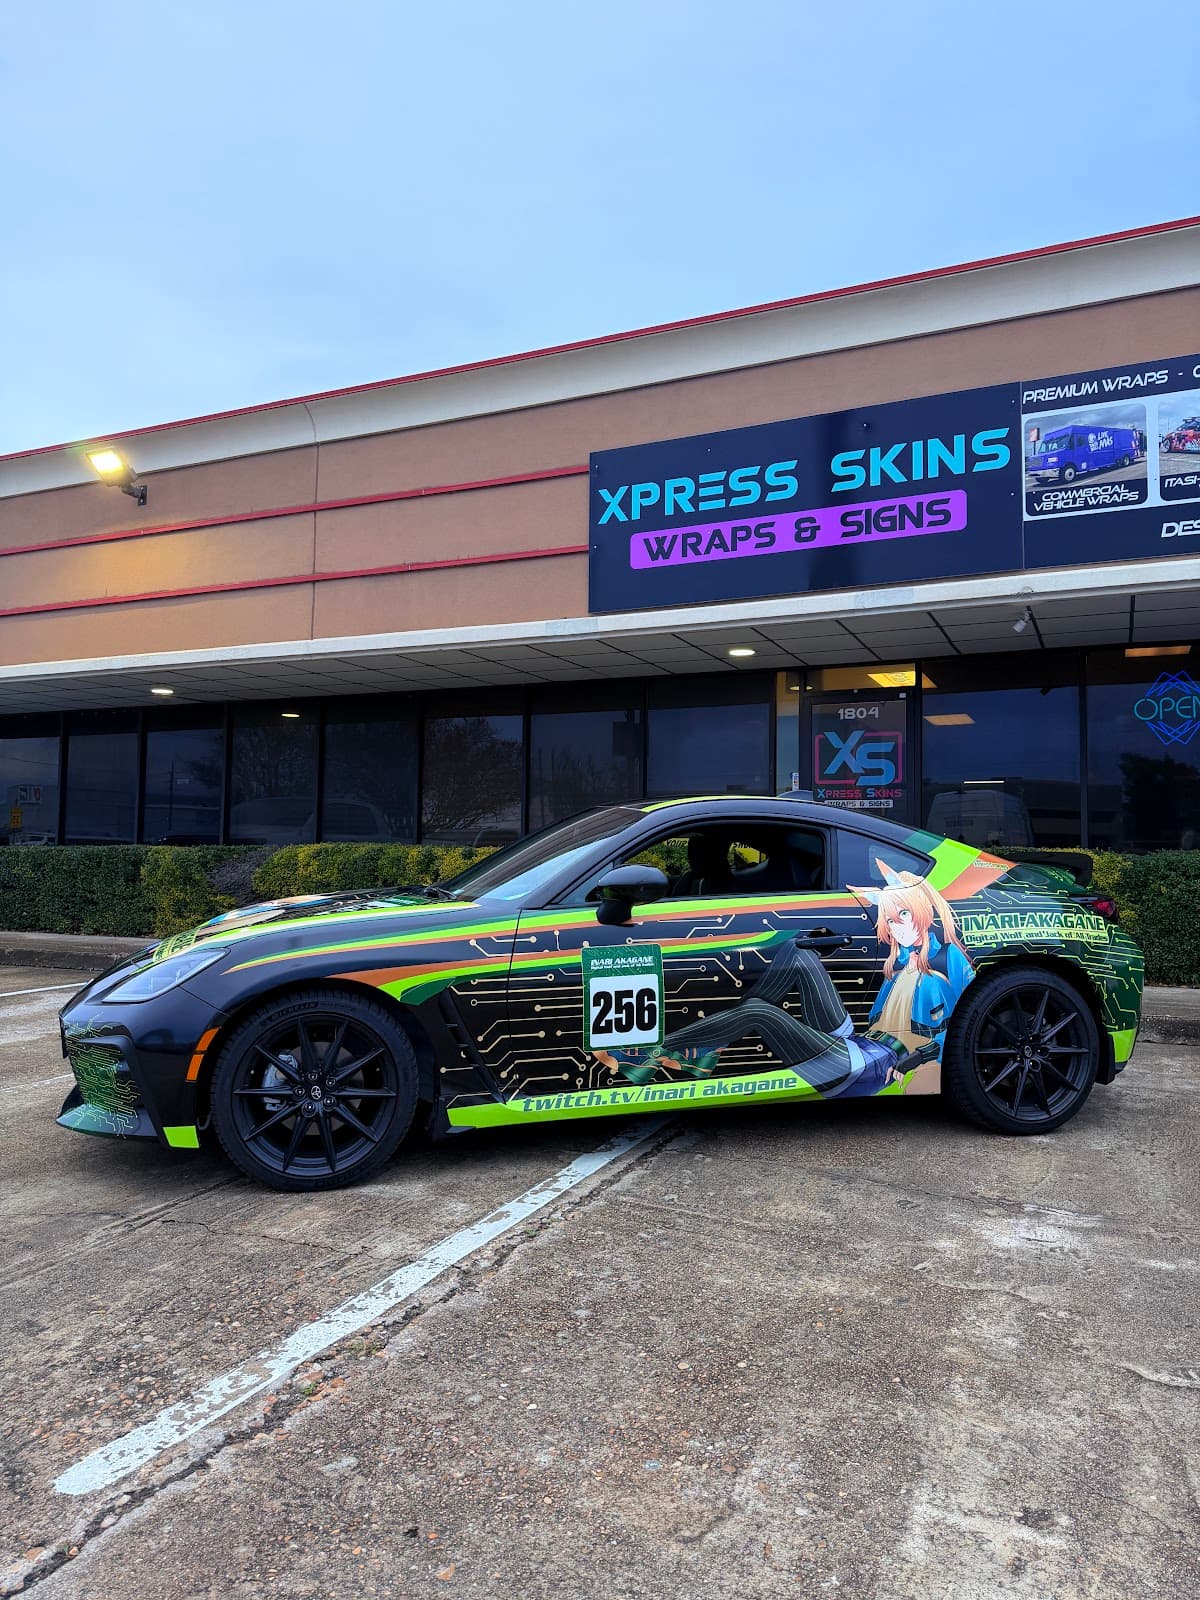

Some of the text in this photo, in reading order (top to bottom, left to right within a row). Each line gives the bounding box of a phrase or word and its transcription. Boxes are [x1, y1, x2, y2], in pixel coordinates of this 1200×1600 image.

[1022, 381, 1098, 404] PREMIUM
[1102, 370, 1168, 391] WRAPS
[598, 427, 1010, 525] XPRESS SKINS
[1033, 491, 1139, 512] VEHICLE WRAPS
[1041, 484, 1129, 501] COMMERCIAL
[643, 496, 952, 562] WRAPS & SIGNS
[837, 706, 879, 720] 1804
[817, 787, 902, 799] XPRESS SKINS
[963, 912, 1105, 931] INARI AKAGANE
[965, 932, 998, 943] Digital
[1000, 931, 1022, 940] Wolf
[592, 988, 657, 1035] 256
[523, 1076, 798, 1113] twitch.tv/inari akagane
